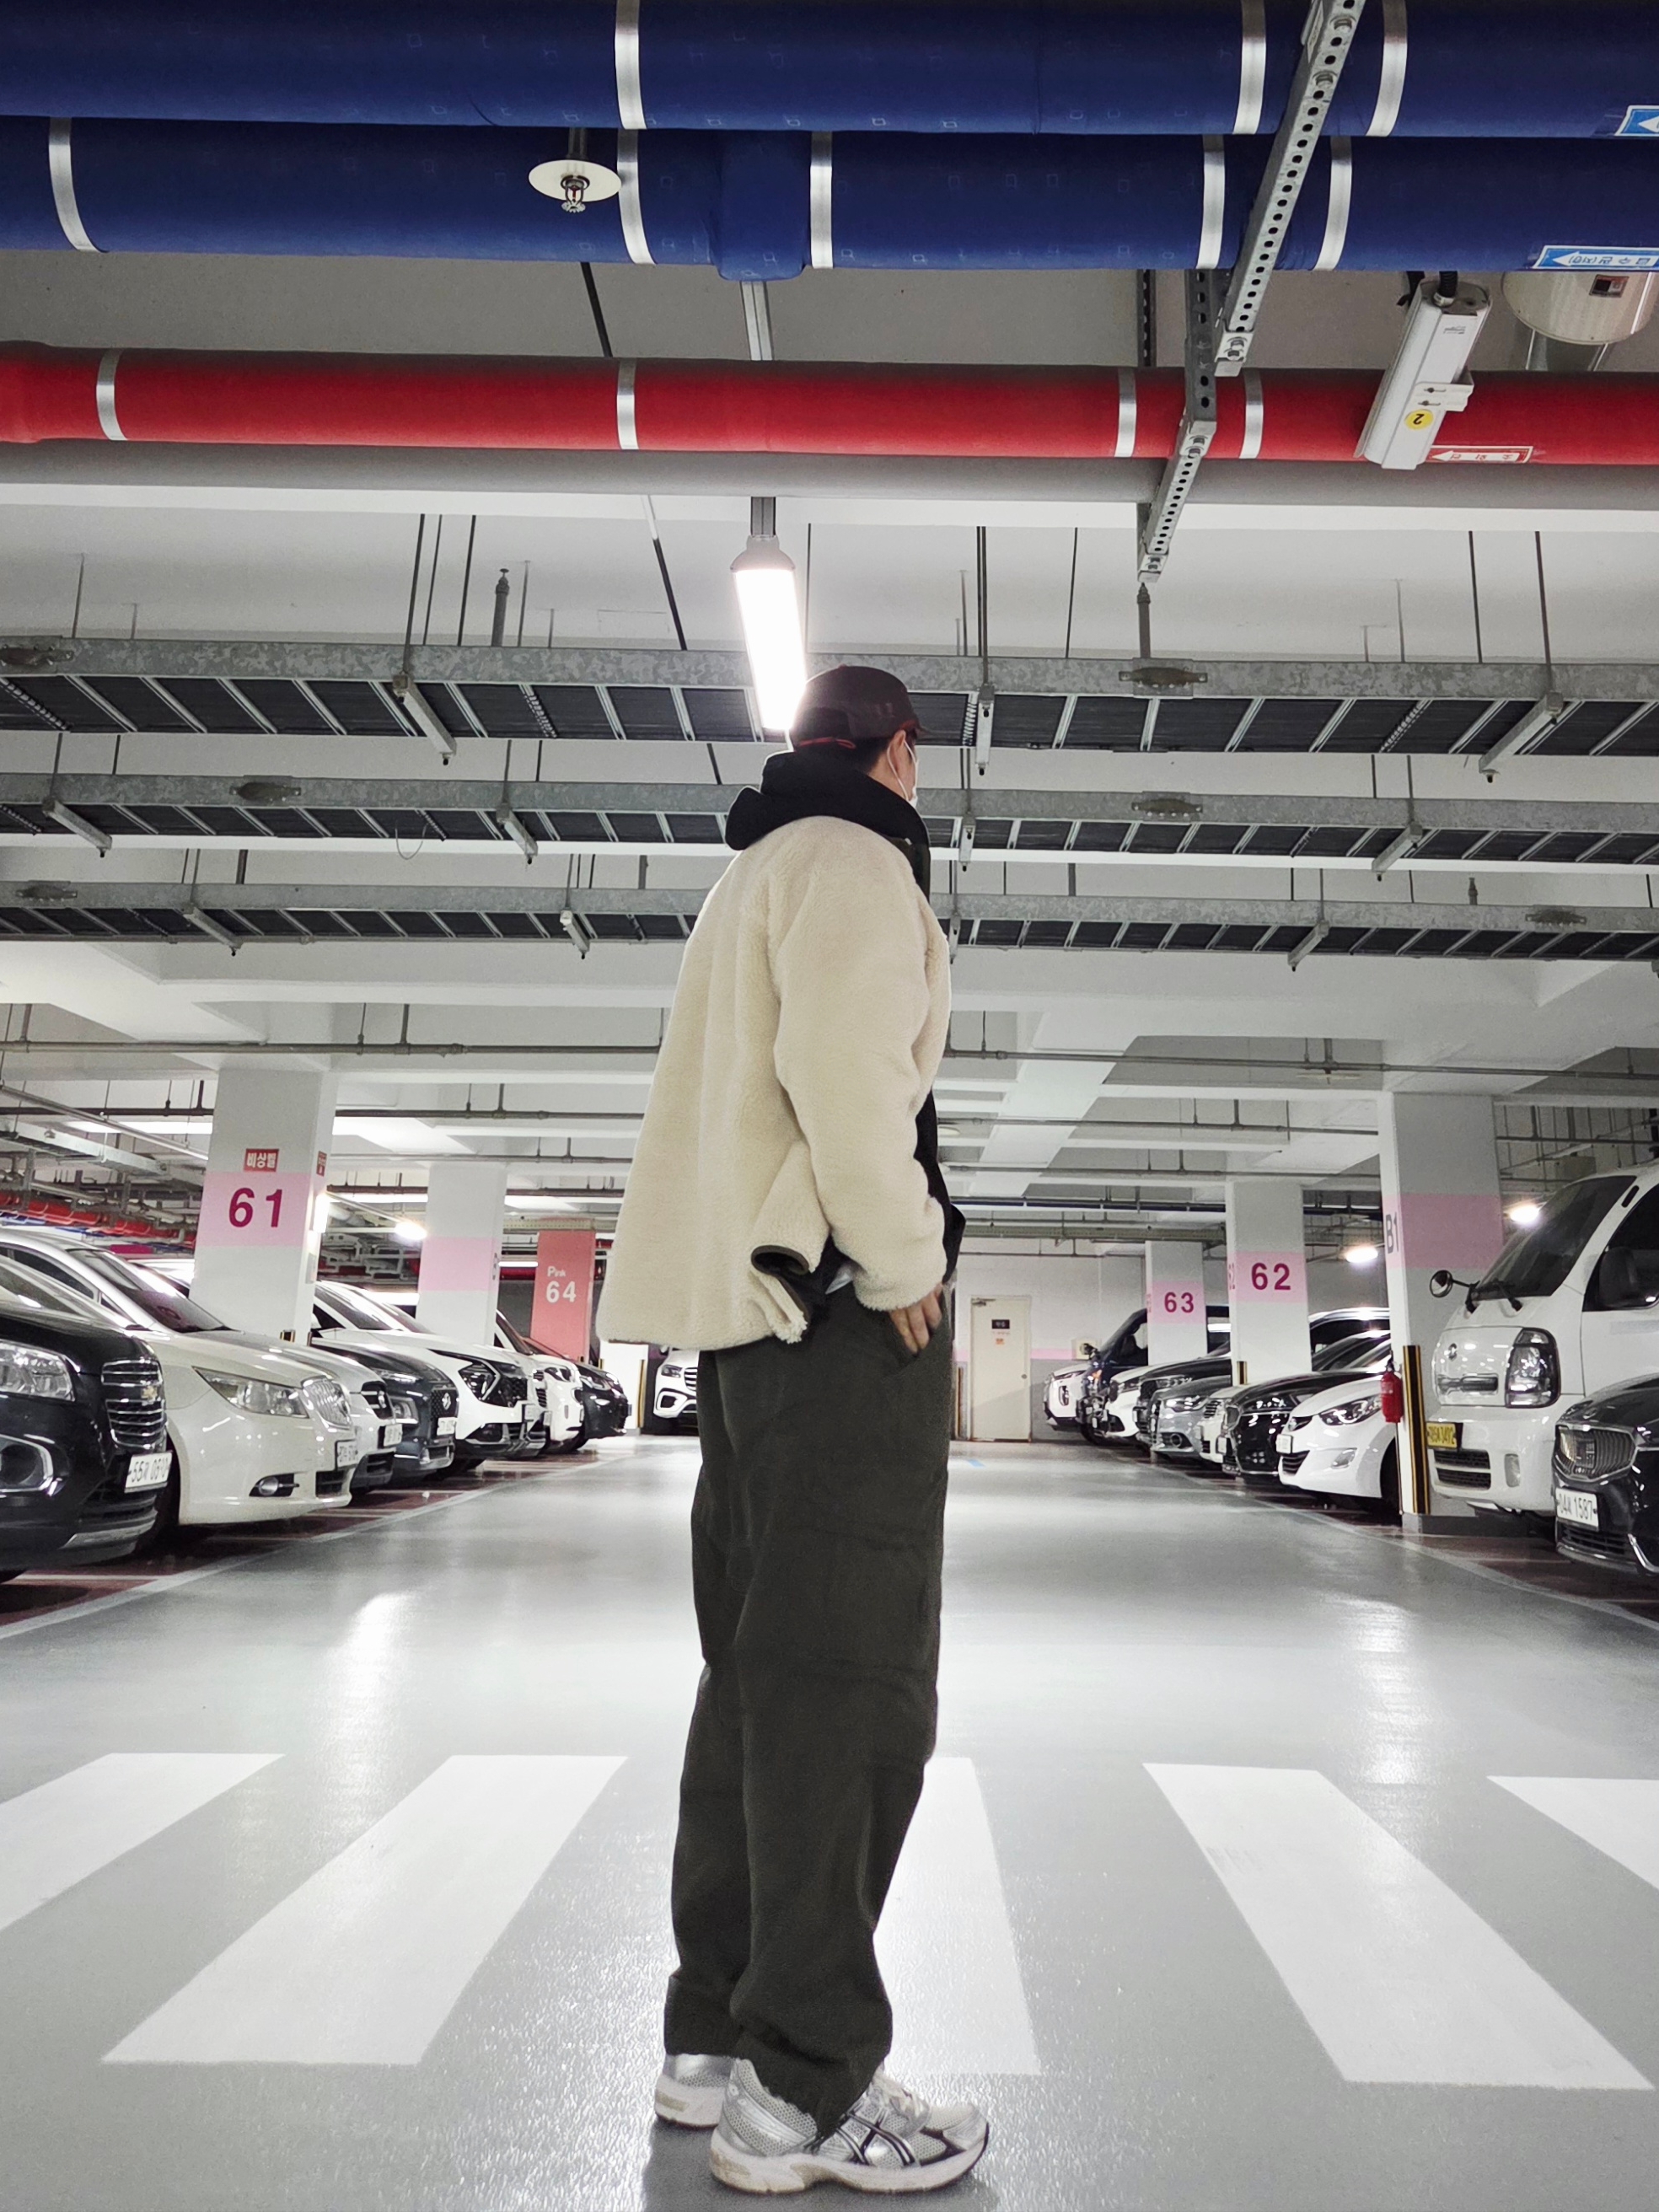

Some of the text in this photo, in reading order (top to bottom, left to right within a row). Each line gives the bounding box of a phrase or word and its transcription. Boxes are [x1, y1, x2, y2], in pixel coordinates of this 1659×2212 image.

[1413, 413, 1425, 425] 2
[246, 1152, 276, 1168] 비상벨
[228, 1187, 282, 1227] 61
[1385, 1211, 1399, 1254] B1
[547, 1265, 566, 1277] Pink
[1251, 1262, 1291, 1291] 62
[546, 1280, 577, 1303] 64
[1164, 1291, 1195, 1313] 63
